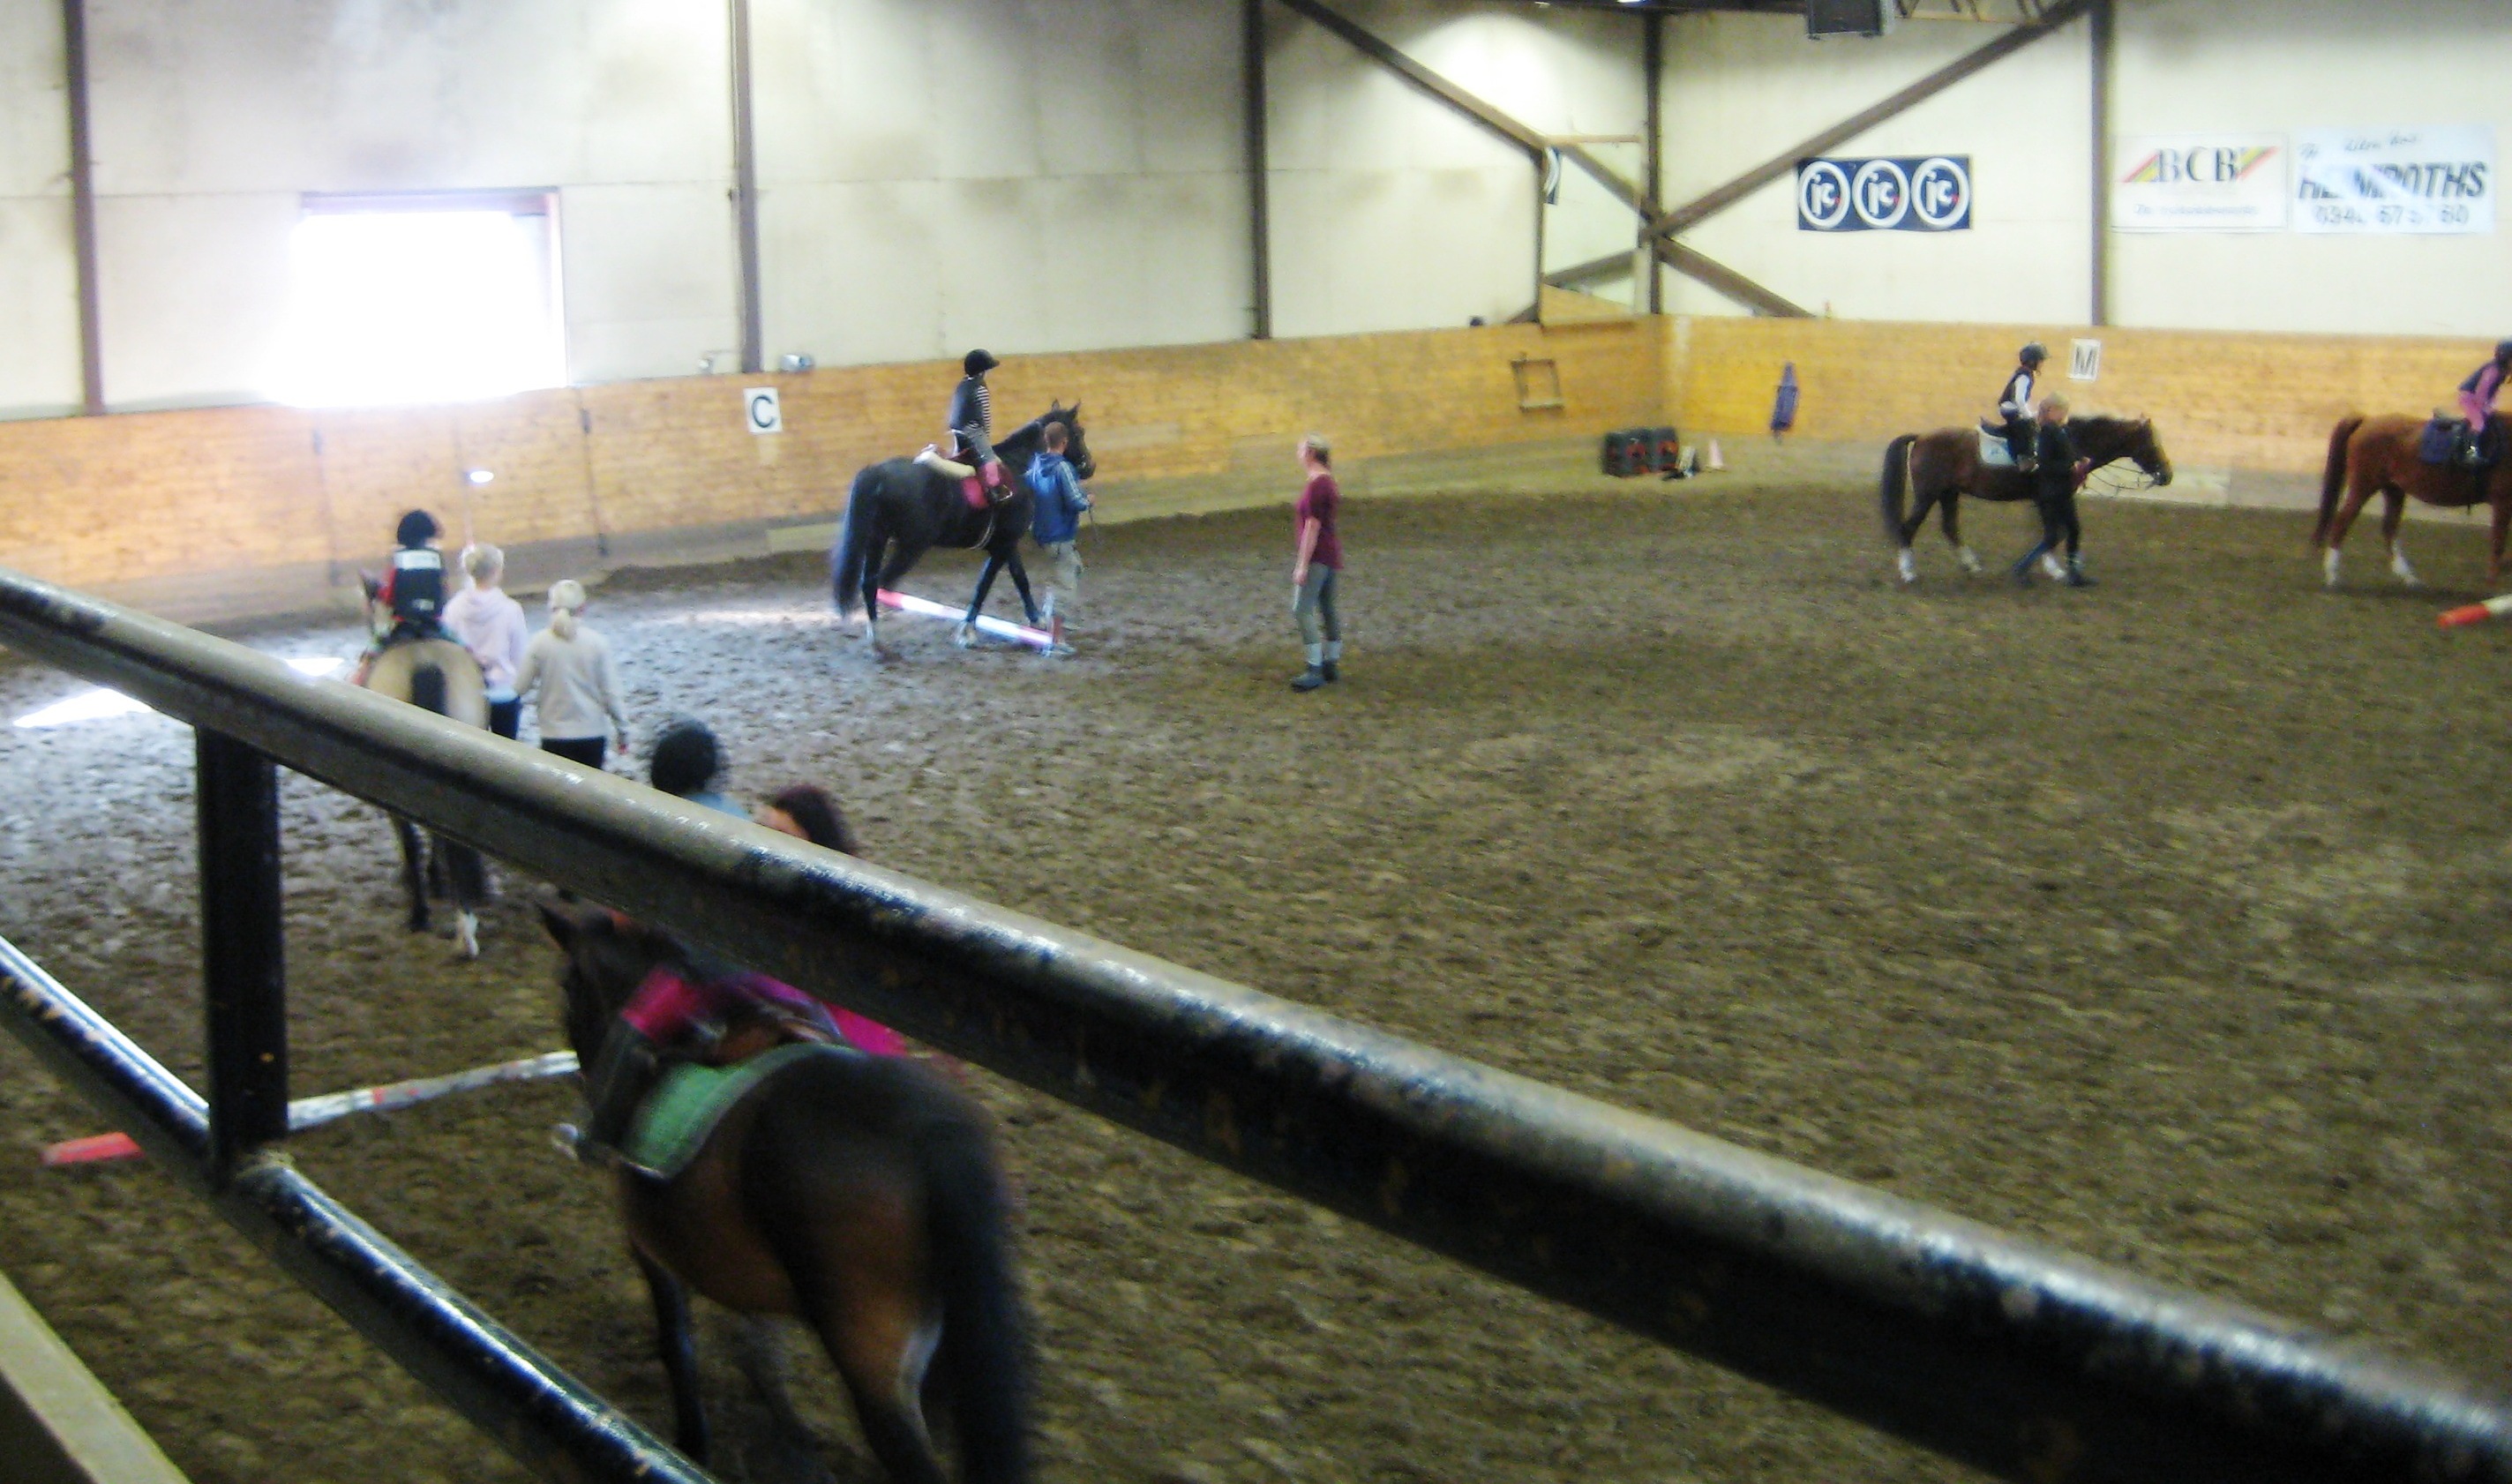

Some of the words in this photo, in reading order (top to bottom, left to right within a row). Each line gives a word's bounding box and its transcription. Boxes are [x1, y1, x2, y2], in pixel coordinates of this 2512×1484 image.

[2158, 145, 2239, 182] BCB
[2074, 345, 2098, 377] M
[752, 394, 776, 429] C
